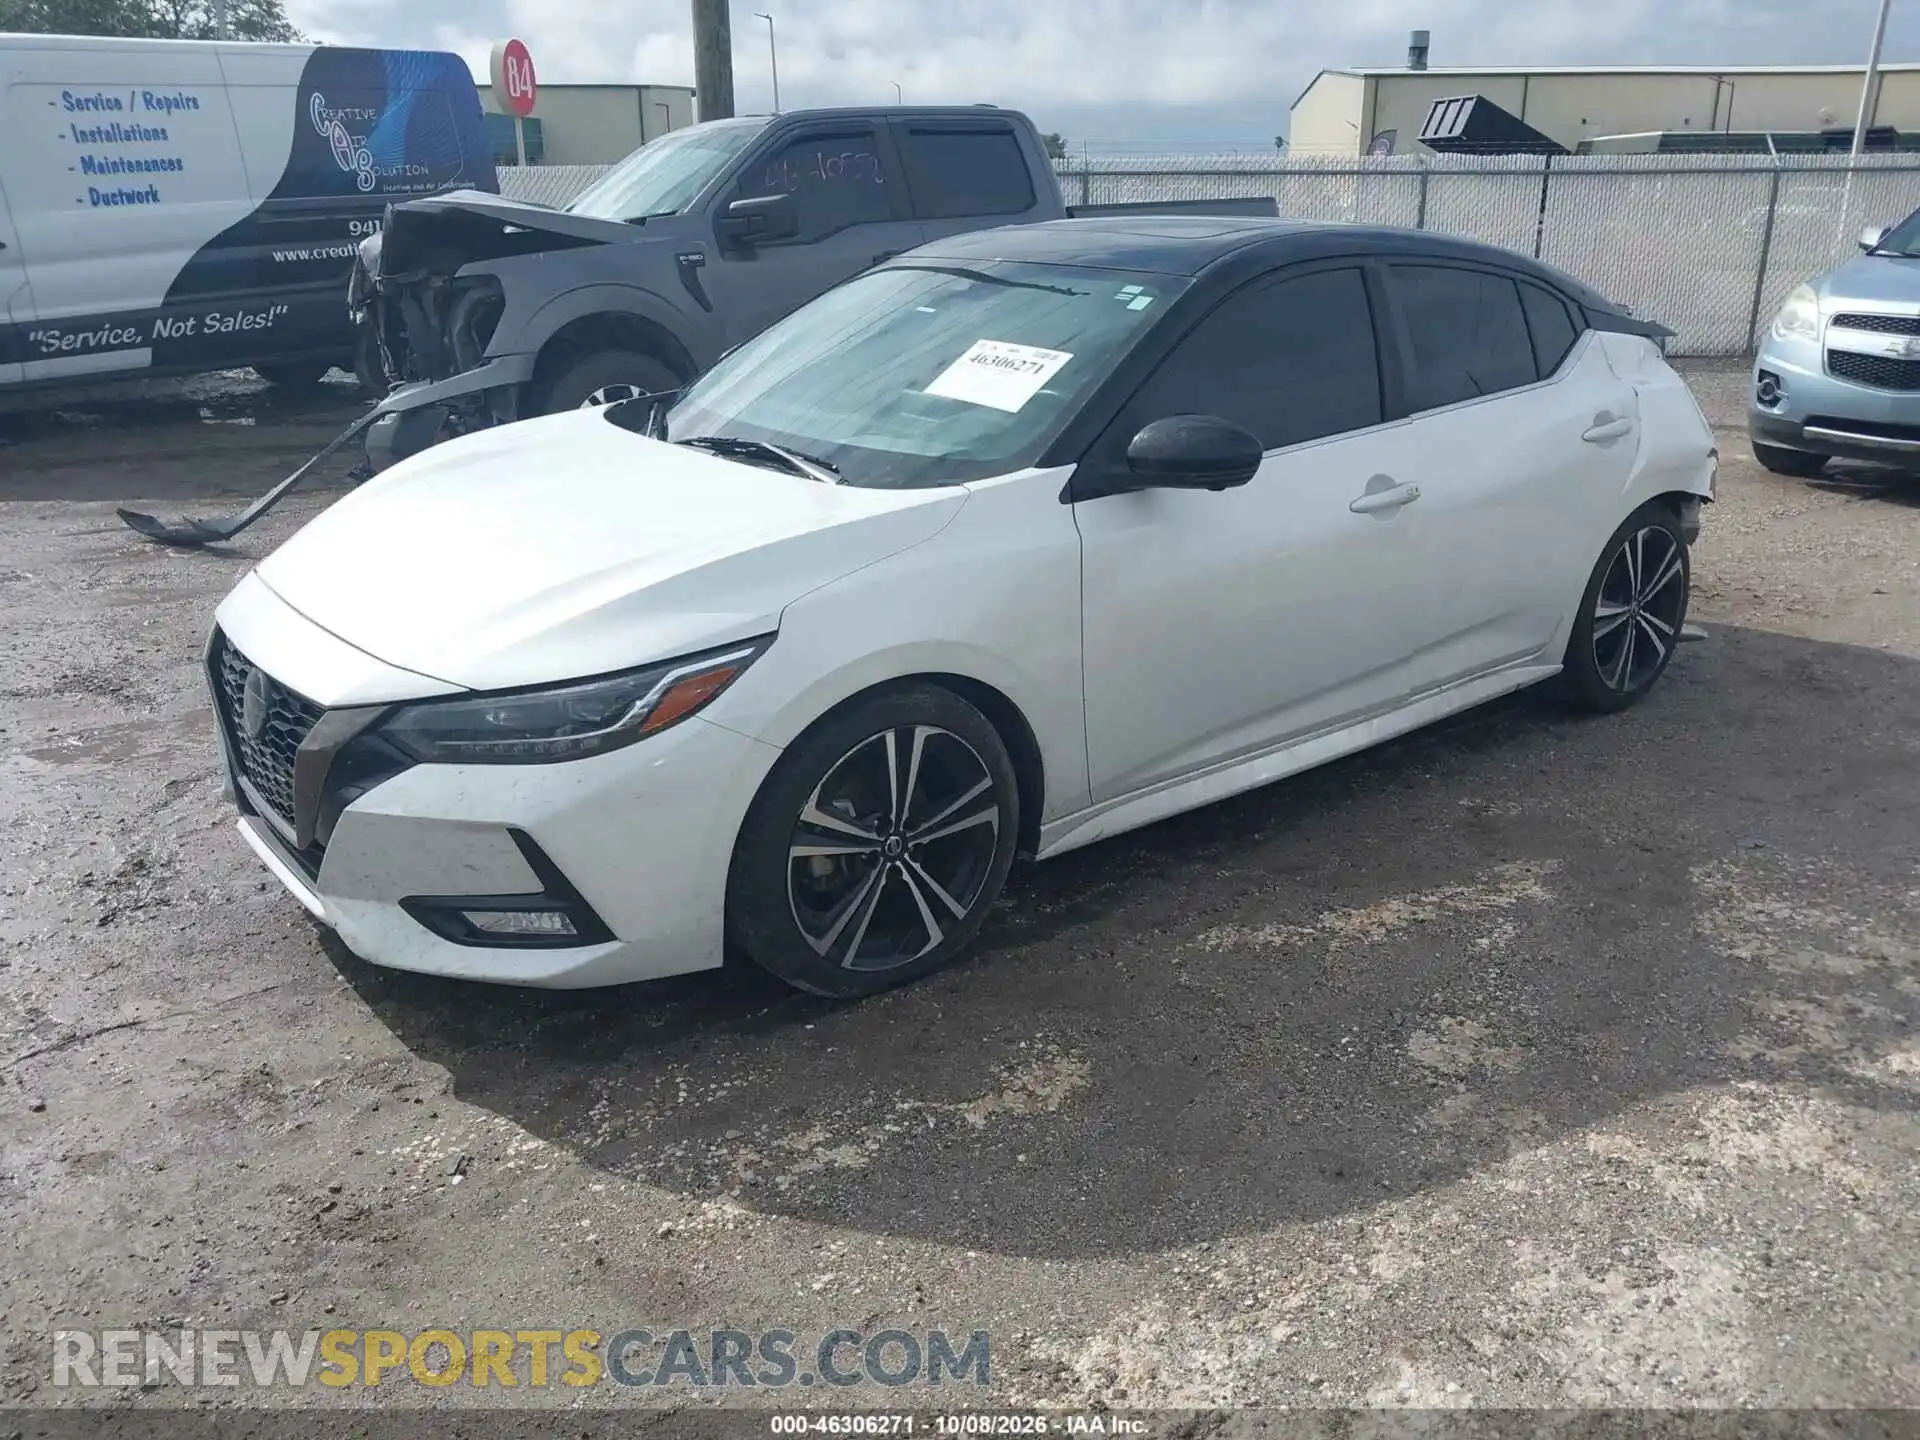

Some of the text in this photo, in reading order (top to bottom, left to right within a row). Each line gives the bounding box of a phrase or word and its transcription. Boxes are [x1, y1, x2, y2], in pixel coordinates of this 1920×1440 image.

[508, 56, 532, 99] 84
[62, 90, 123, 113] Service
[142, 91, 200, 116] Repairs
[71, 122, 169, 144] Installations
[80, 155, 184, 175] Maintenances
[88, 184, 161, 207] Ductwork
[272, 242, 362, 263] www.creati
[29, 305, 288, 352] "Service, Not Sales!"
[970, 351, 1045, 375] 46306271
